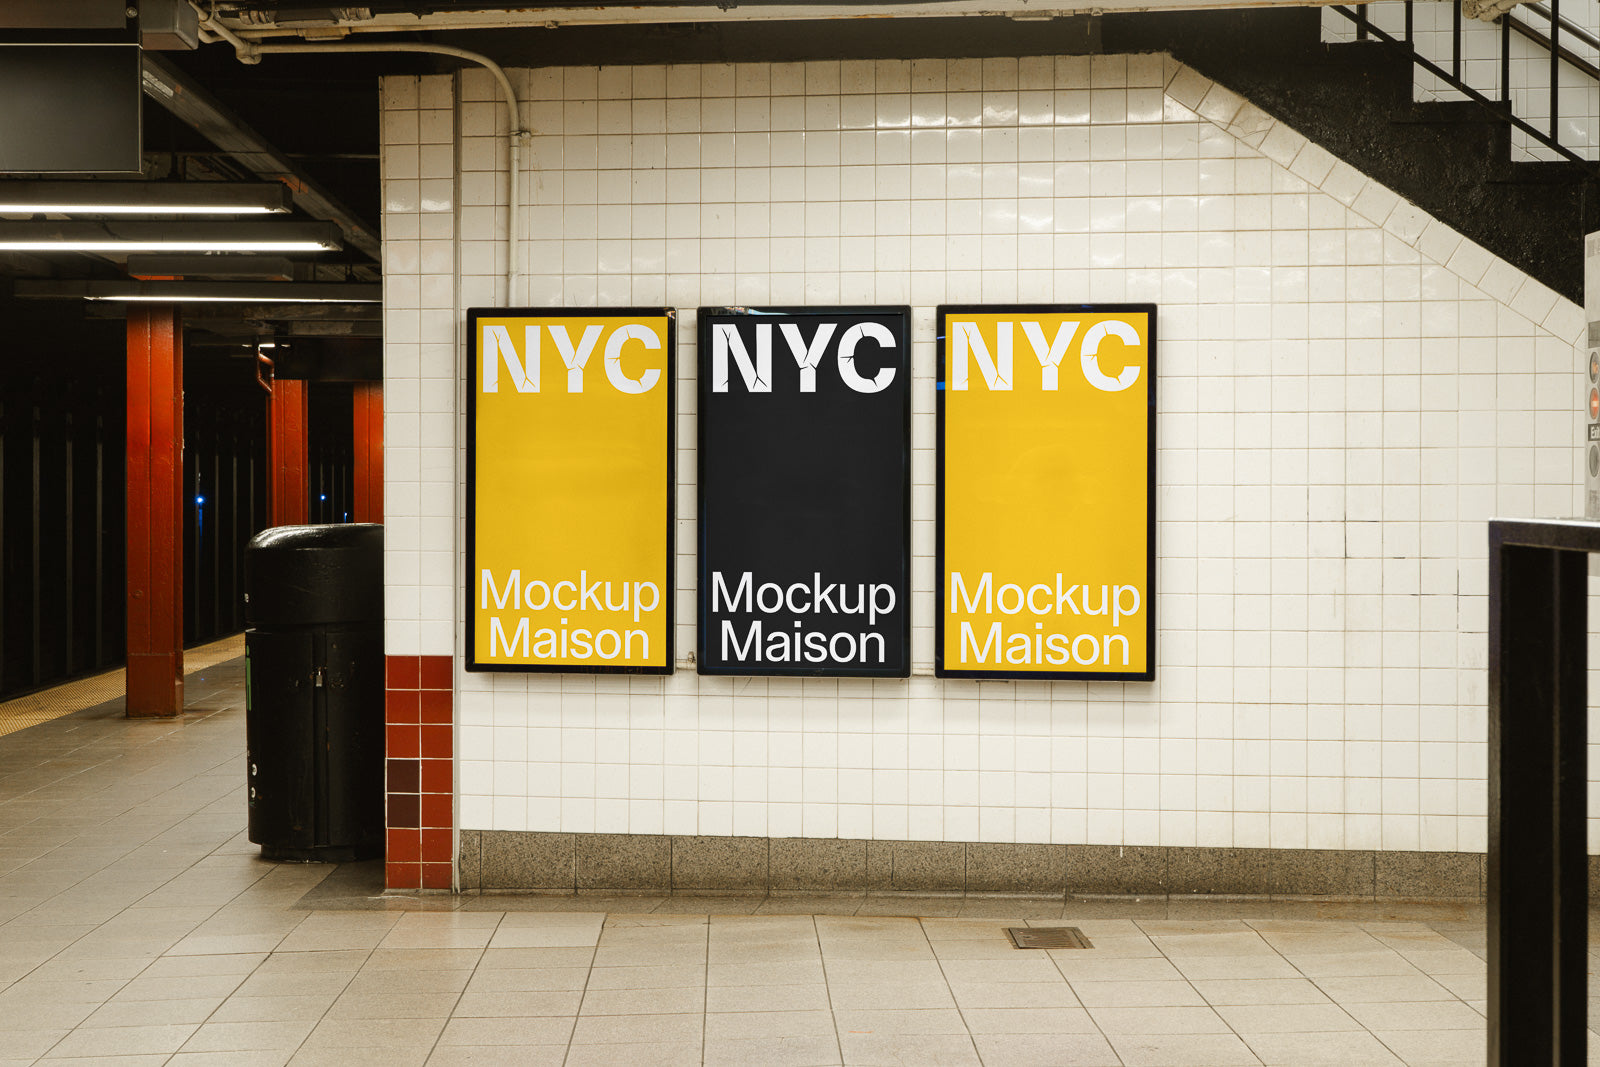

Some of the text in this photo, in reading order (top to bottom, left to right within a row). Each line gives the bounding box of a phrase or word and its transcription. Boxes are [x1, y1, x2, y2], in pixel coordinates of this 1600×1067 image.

[483, 325, 661, 394] NYC
[713, 322, 896, 393] NYC
[952, 320, 1141, 391] NYC
[481, 569, 660, 622] Mockup
[712, 572, 896, 625] Mockup
[951, 572, 1140, 626] Mockup
[490, 617, 649, 659] Maison
[721, 620, 885, 663] Maison
[960, 623, 1129, 665] Maison
